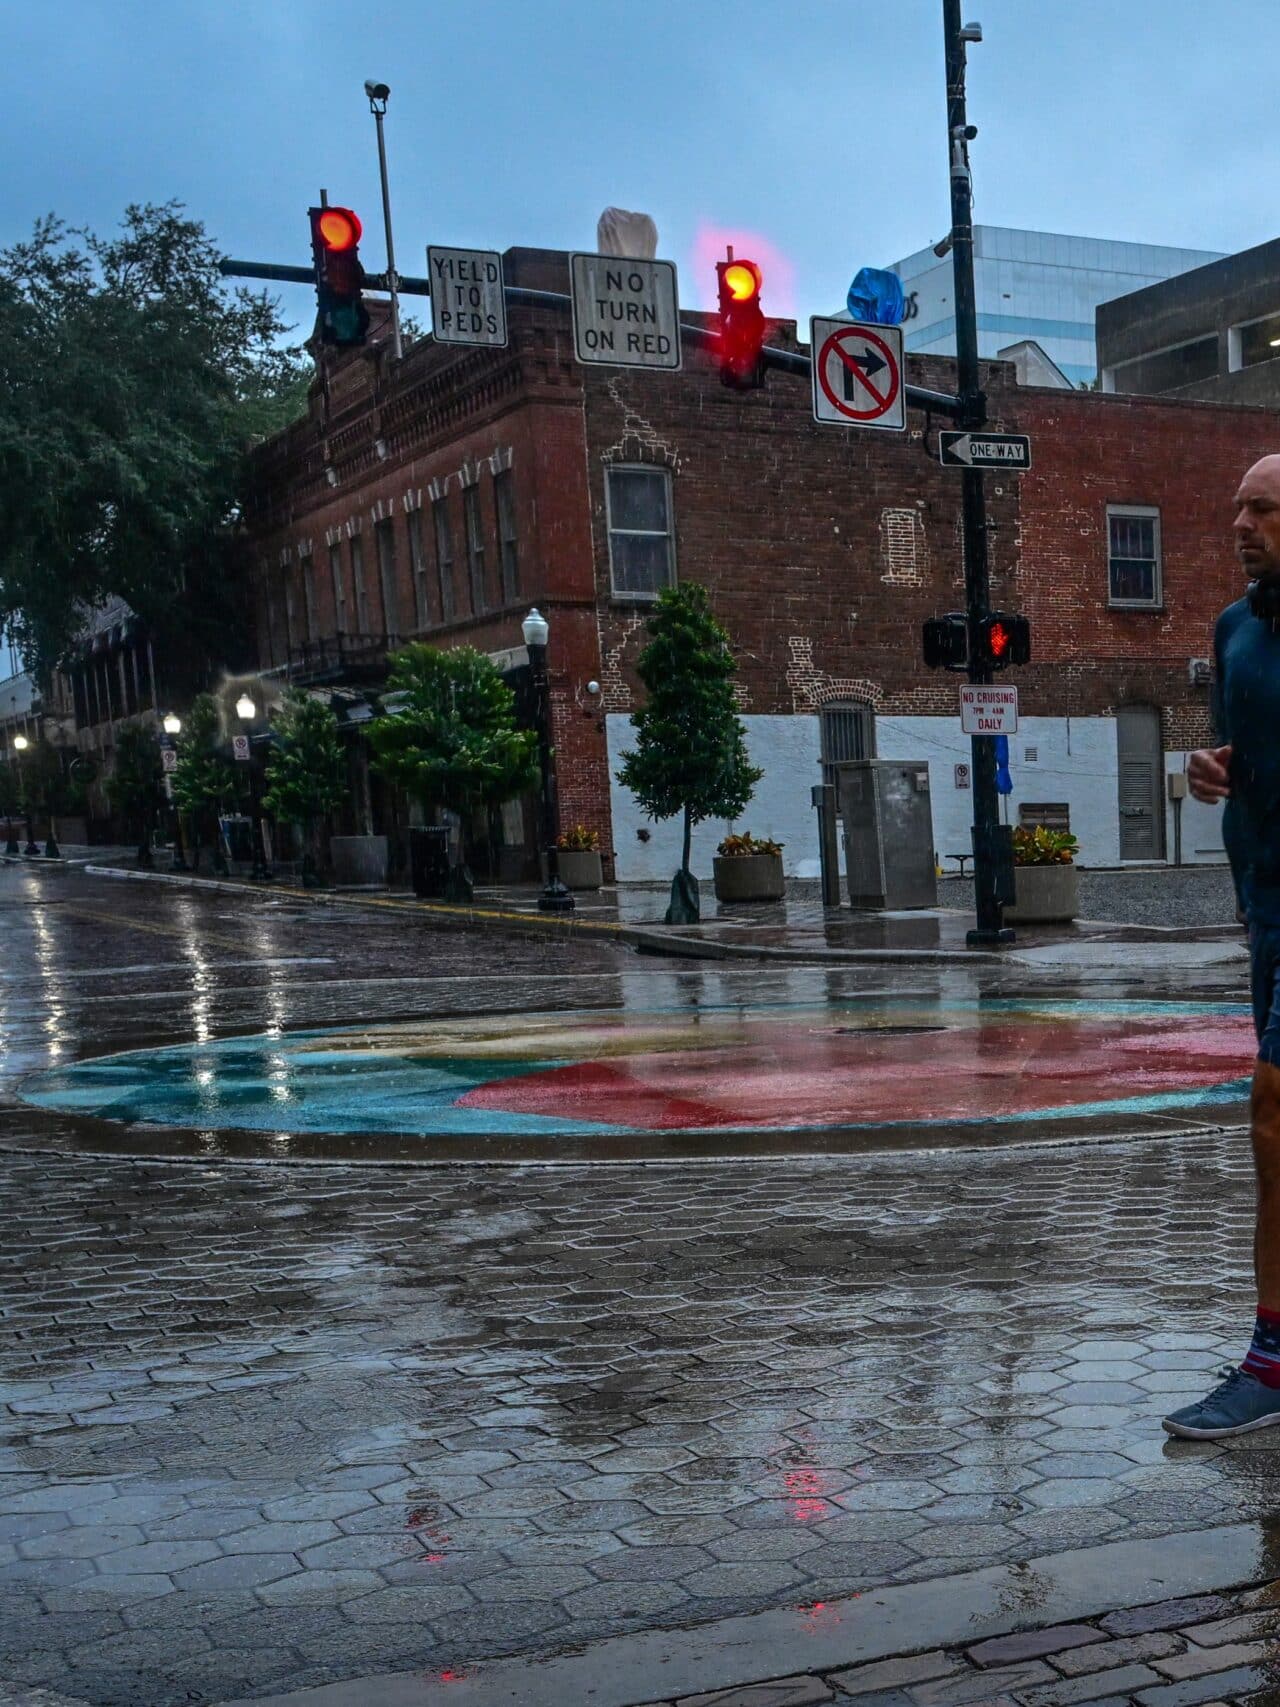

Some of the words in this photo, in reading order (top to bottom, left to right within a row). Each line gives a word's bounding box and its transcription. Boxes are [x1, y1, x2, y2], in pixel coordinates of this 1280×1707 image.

[433, 257, 498, 282] YIELD
[606, 271, 643, 292] NO
[454, 285, 481, 307] TO
[595, 299, 656, 324] TURN
[441, 311, 498, 334] PEDS
[585, 329, 614, 350] ON
[627, 333, 670, 354] RED
[970, 443, 992, 457] ONE
[997, 445, 1022, 458] WAY
[962, 692, 974, 703] NO
[977, 692, 1015, 704] CRUISING
[972, 706, 985, 715] 7PM
[992, 707, 1005, 715] 4AM
[978, 718, 1002, 730] DAILY
